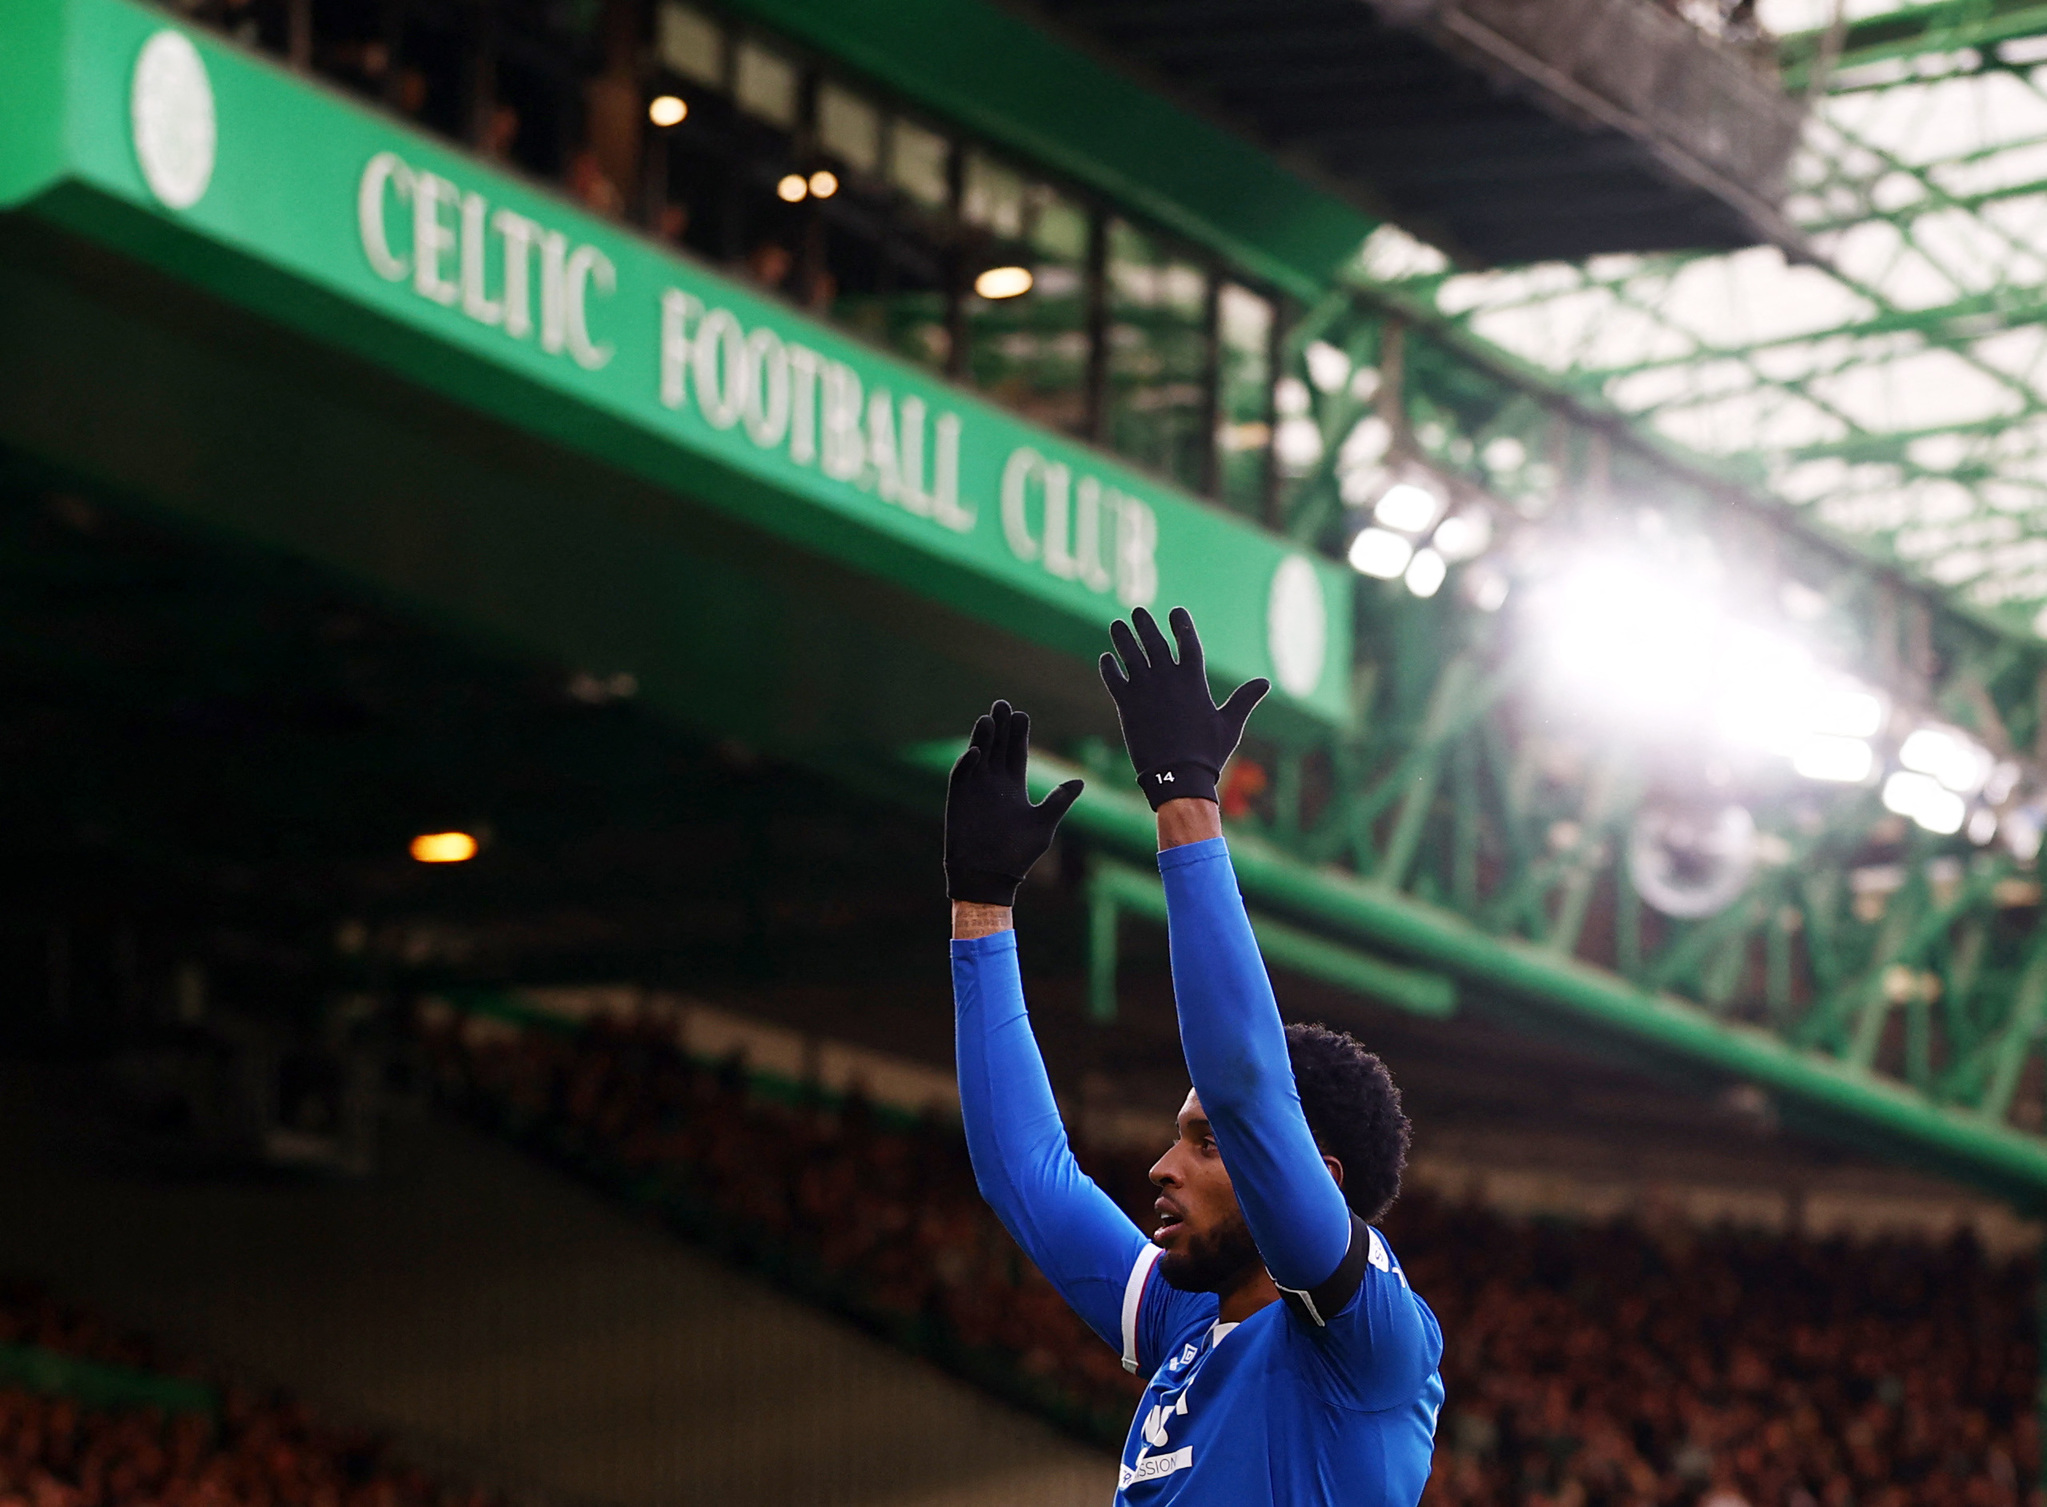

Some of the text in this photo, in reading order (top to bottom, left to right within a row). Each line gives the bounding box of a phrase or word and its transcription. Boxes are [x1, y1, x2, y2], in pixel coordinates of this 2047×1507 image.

[358, 152, 1159, 607] CELTIC FOOTBALL CLUB
[1155, 771, 1175, 784] 14
